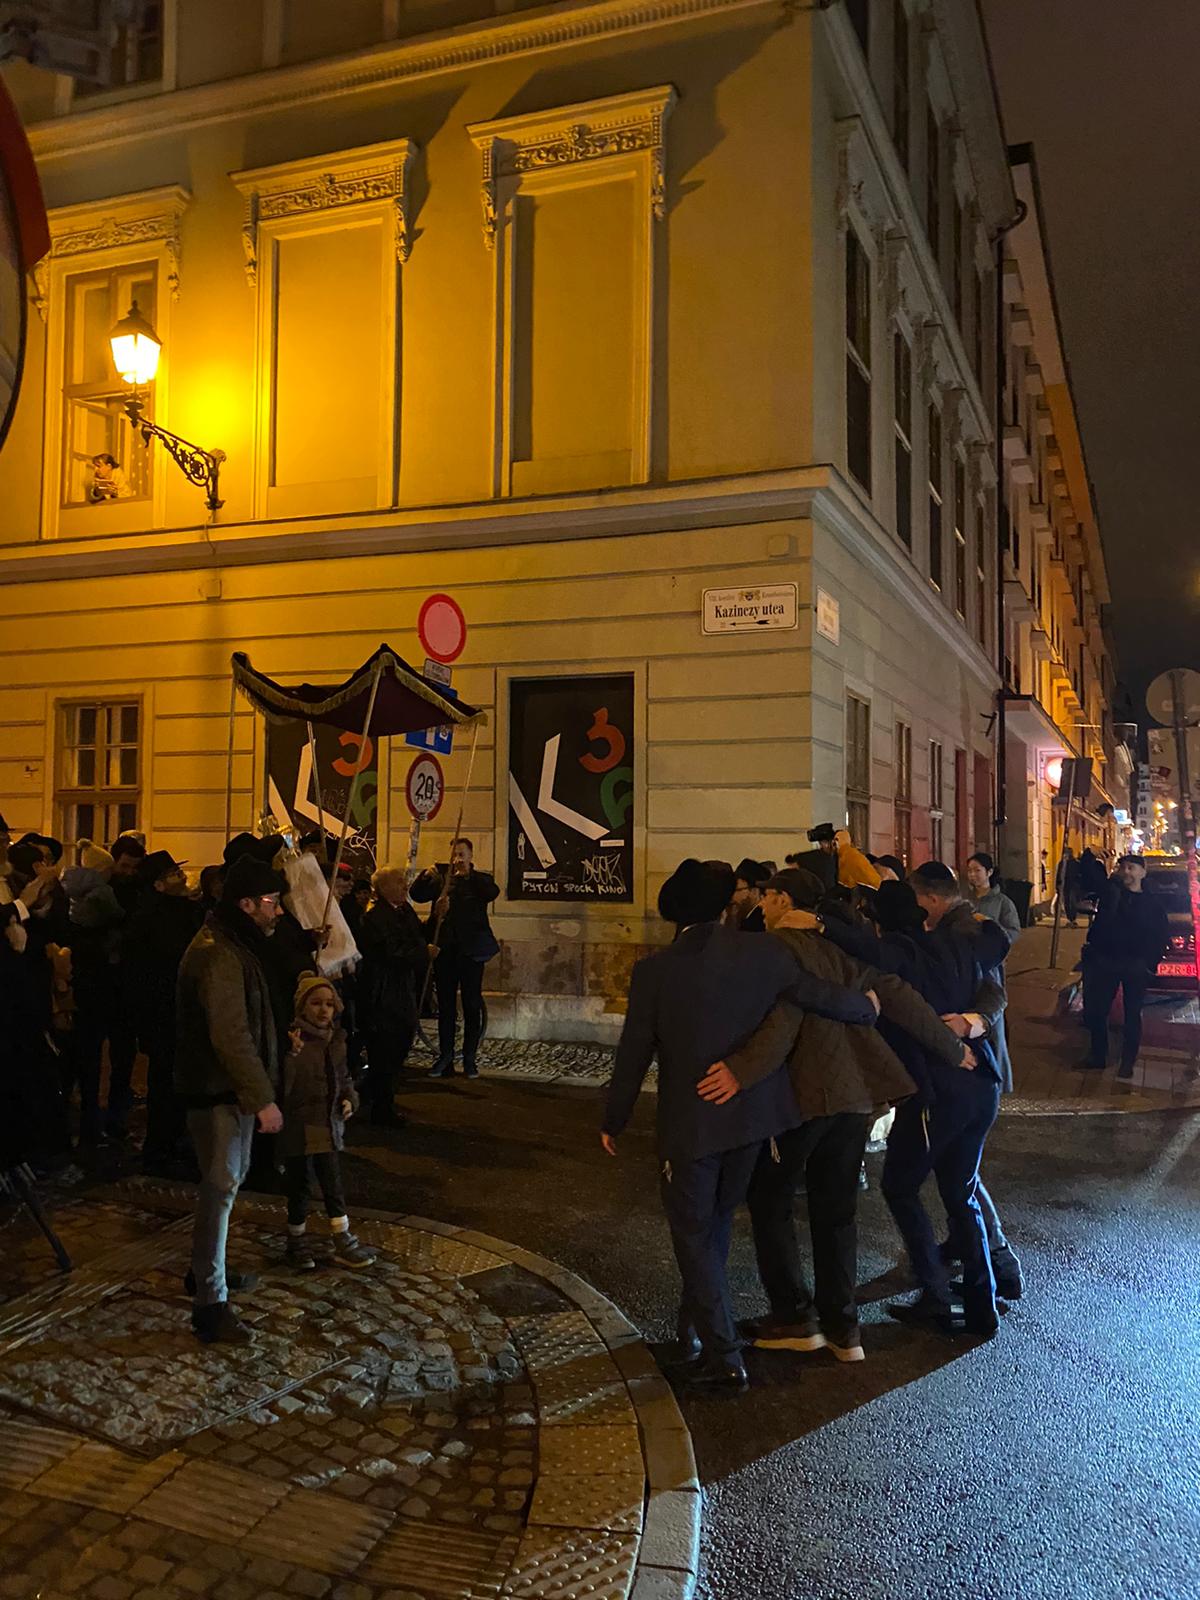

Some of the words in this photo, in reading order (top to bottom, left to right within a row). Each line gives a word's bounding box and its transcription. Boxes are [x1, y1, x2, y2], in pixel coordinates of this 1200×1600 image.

[715, 604, 760, 619] Kazinczy
[762, 603, 785, 615] utca
[415, 772, 434, 800] 20
